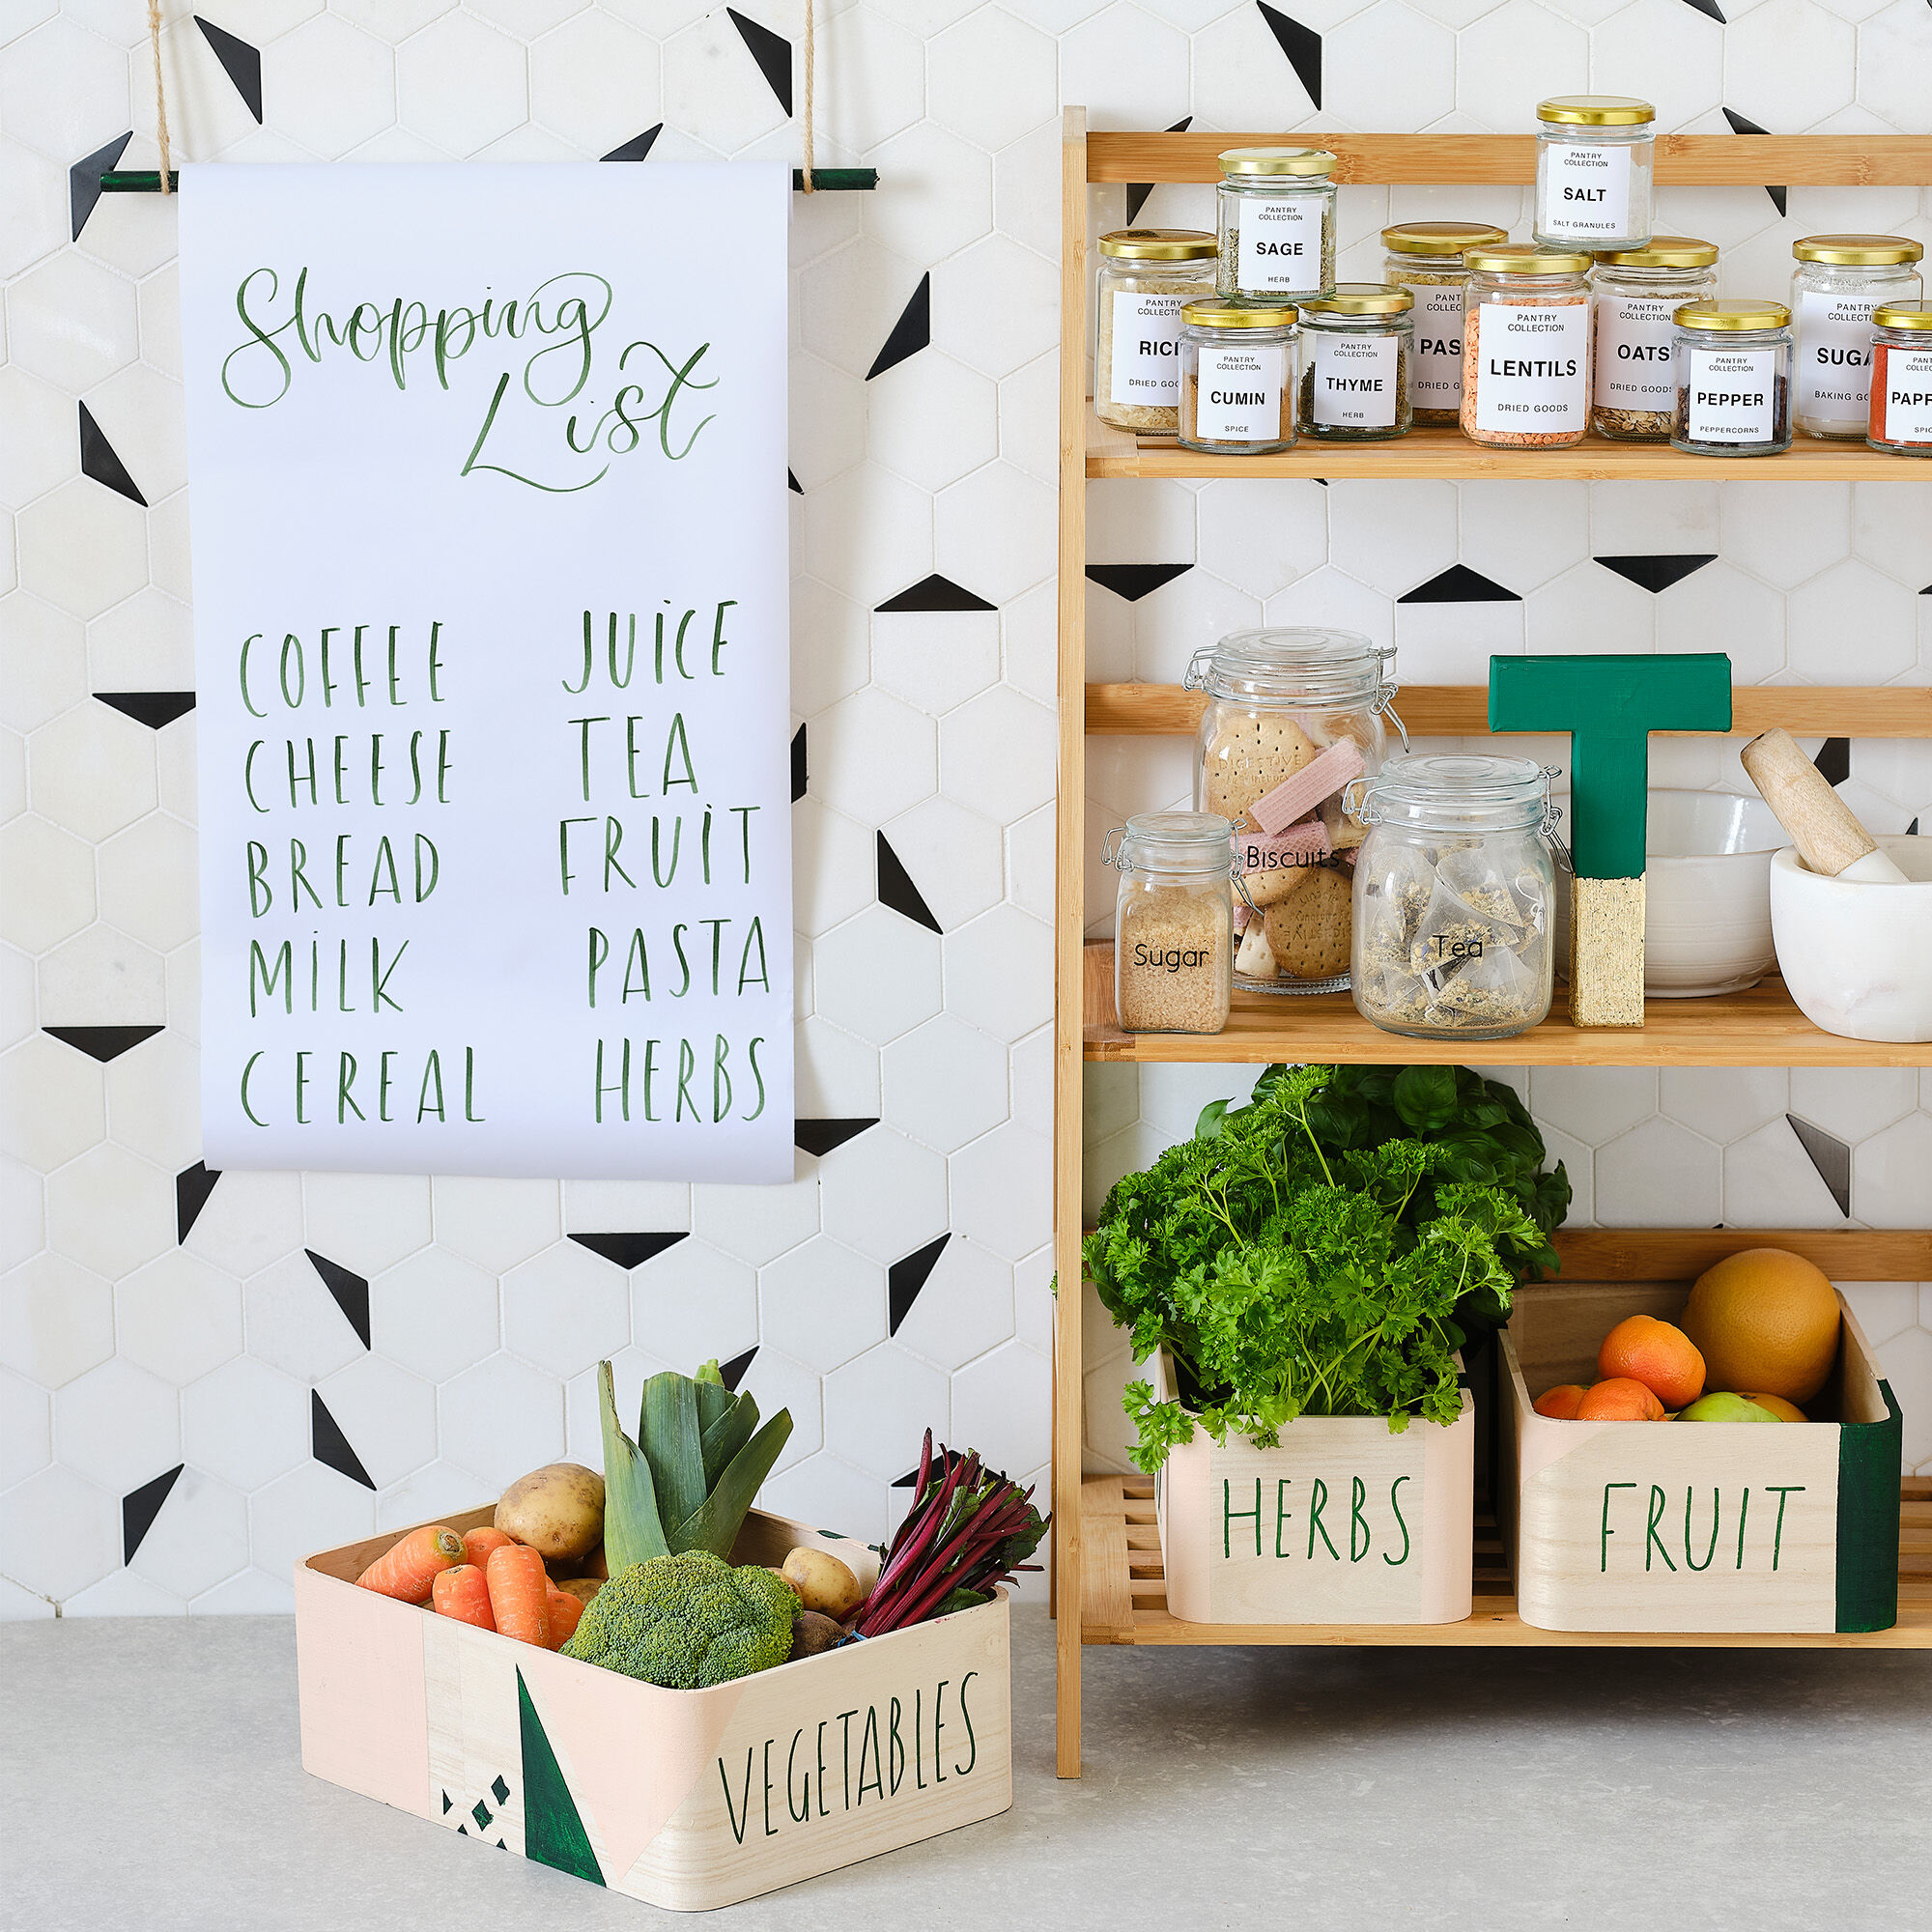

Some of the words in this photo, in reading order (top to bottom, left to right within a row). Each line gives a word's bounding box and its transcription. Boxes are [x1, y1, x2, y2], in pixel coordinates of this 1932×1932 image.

[1563, 158, 1608, 168] COLLECTION
[1563, 186, 1607, 202] SALT
[1572, 221, 1616, 230] GRANULES
[1256, 242, 1304, 256] SAGE
[1145, 298, 1183, 307] PANTRY
[1426, 302, 1462, 312] COLLEC
[1627, 302, 1664, 312] PANTRY
[1137, 307, 1180, 317] COLLECTI
[1517, 313, 1557, 322] PANTRY
[1619, 309, 1671, 322] COLLECTION
[1828, 312, 1872, 323] COLLECTI
[1507, 323, 1565, 332] COLLECTION
[222, 267, 612, 408] Shopping
[1333, 350, 1378, 358] COLLECTION
[1340, 342, 1372, 351] PANTRY
[1420, 338, 1462, 356] PAS
[1617, 344, 1670, 362] OATS
[1216, 362, 1262, 371] COLLECTION
[1491, 358, 1577, 378] LENTILS
[1708, 364, 1754, 373] COLLECTION
[1128, 378, 1157, 387] DRIED
[1325, 377, 1383, 392] THYME
[1417, 381, 1449, 390] DRIED
[1609, 382, 1637, 392] DRIED
[1210, 390, 1265, 406] CUMIN
[1697, 391, 1764, 407] PEPPER
[1814, 390, 1852, 401] BAKING
[1497, 403, 1530, 412] DRIED
[1533, 403, 1569, 413] GOODS
[461, 342, 720, 492] List
[1699, 425, 1760, 434] PEPPERCORNS
[240, 620, 445, 718] COFFEE
[567, 712, 698, 802] TEA
[245, 729, 453, 813] CHEESE
[1247, 845, 1340, 867] Biscuits
[246, 833, 439, 919] BREAD
[1433, 935, 1482, 957] Tea
[588, 916, 770, 1009] PASTA
[1133, 943, 1210, 971] Sugar
[241, 1046, 486, 1127] CEREAL
[595, 1034, 765, 1124] HERBS
[1223, 1475, 1411, 1566] HERBS
[1601, 1482, 1806, 1573] FRUIT
[718, 1671, 979, 1845] VEGETABLES
